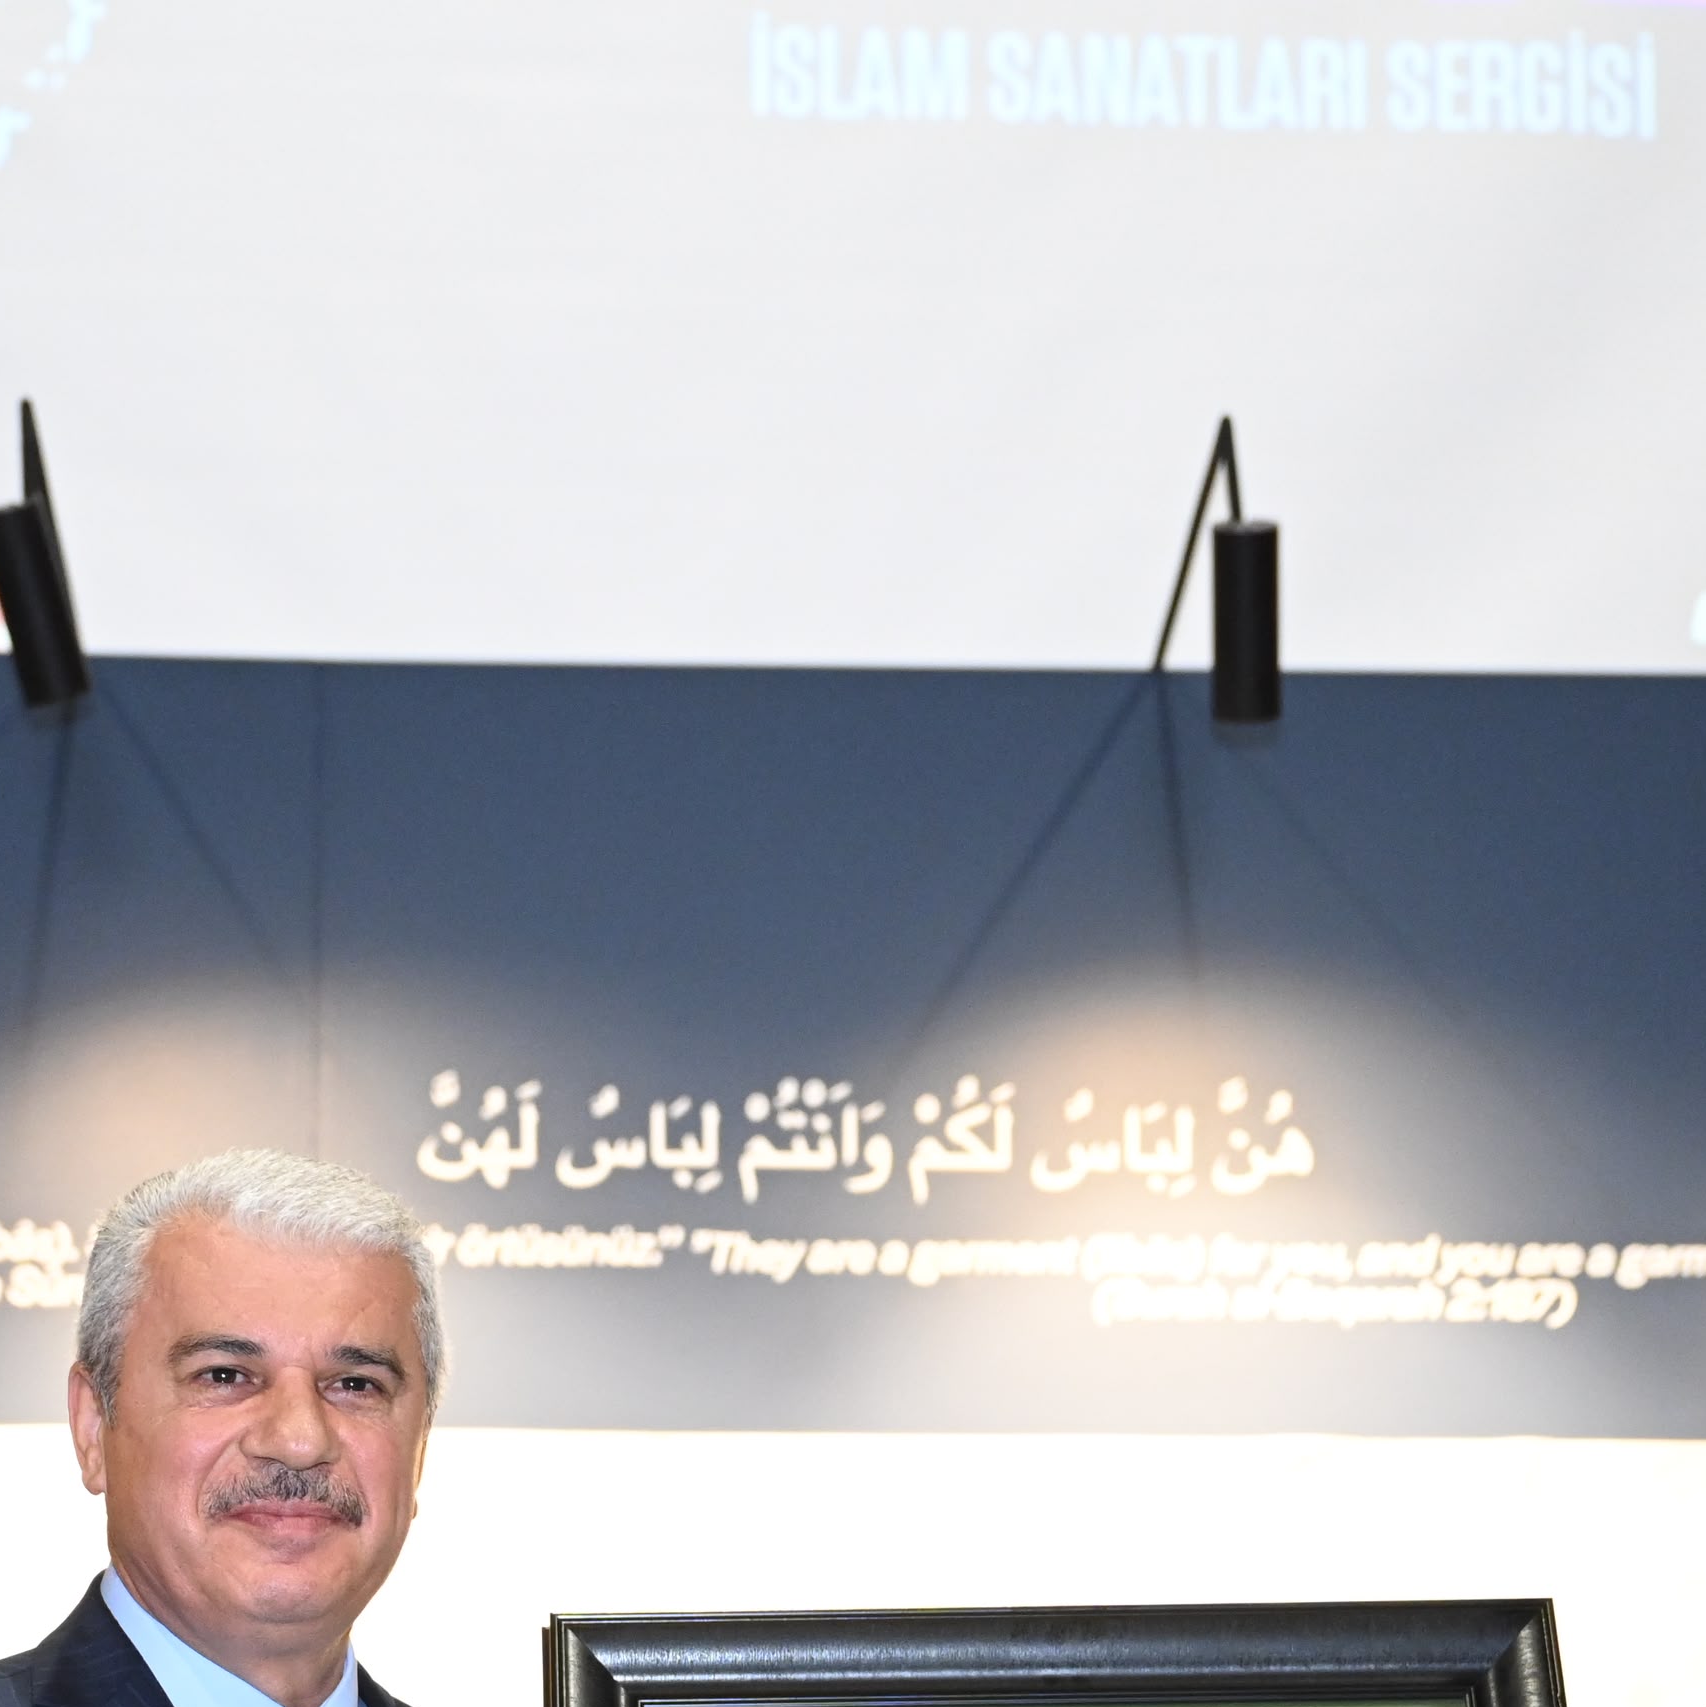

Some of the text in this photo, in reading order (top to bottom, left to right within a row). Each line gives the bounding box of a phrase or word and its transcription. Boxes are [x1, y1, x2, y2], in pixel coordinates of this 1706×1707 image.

[749, 10, 1657, 141] İSLAM SANATLARI SERGİSİ
